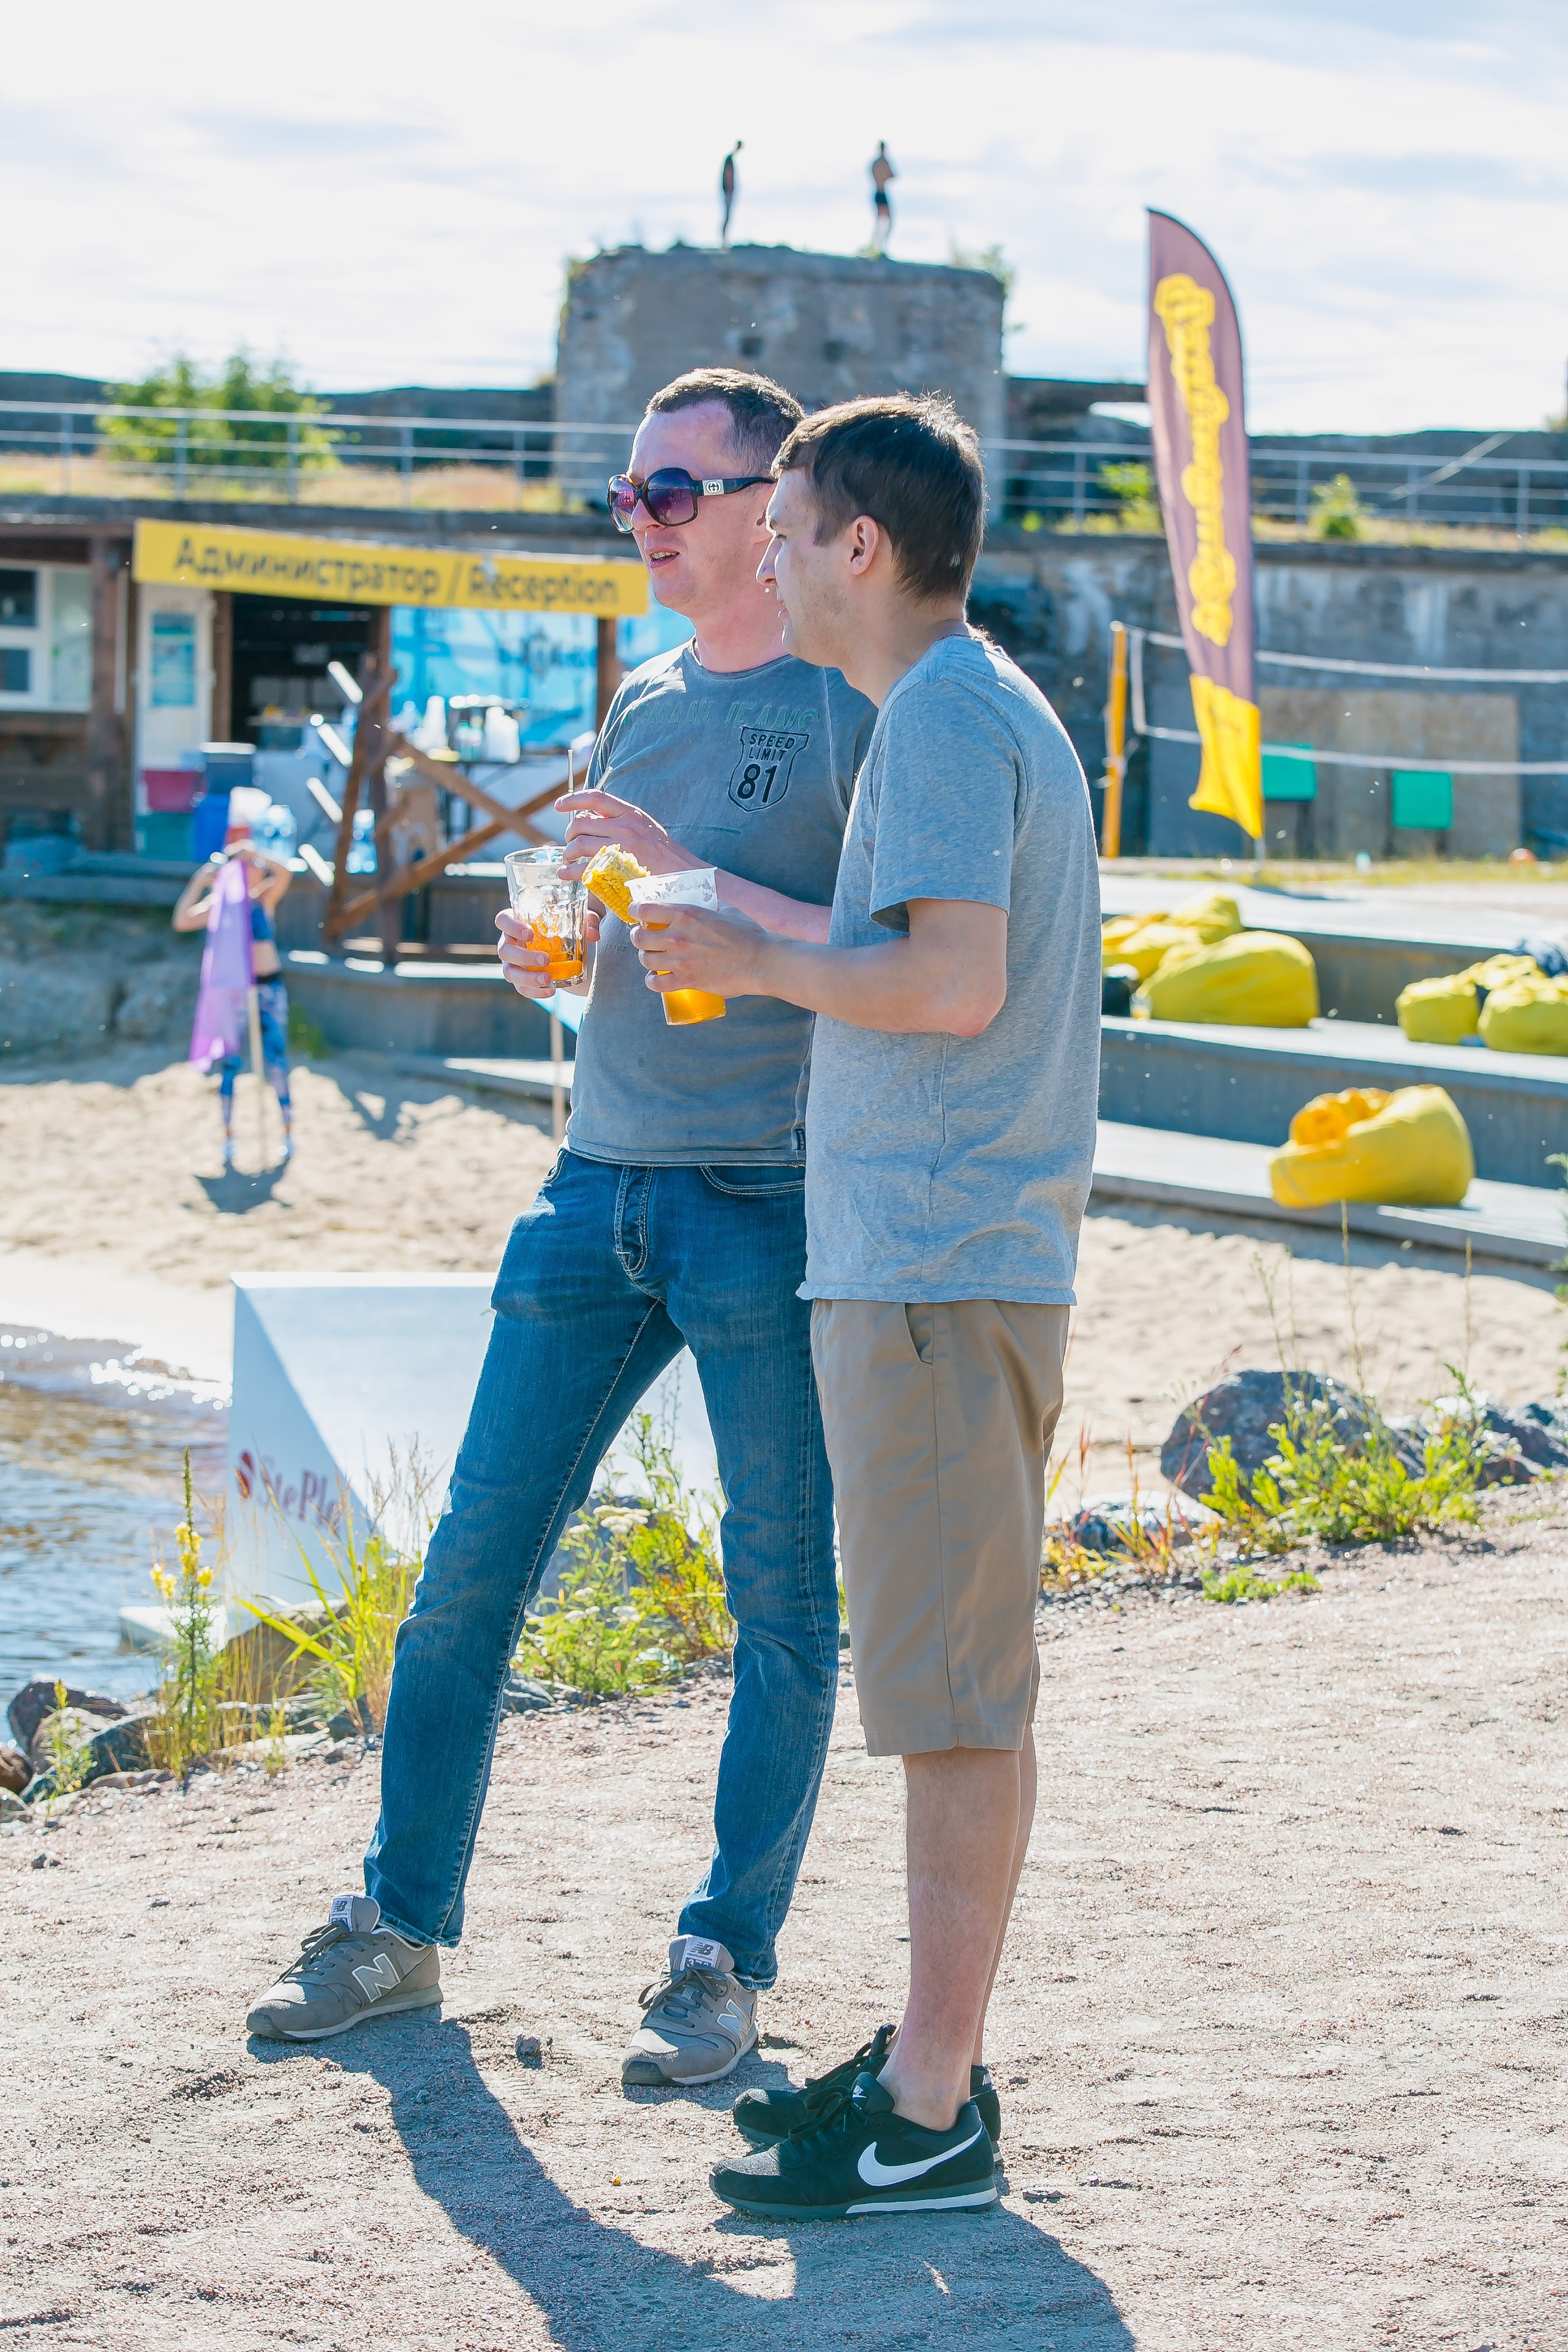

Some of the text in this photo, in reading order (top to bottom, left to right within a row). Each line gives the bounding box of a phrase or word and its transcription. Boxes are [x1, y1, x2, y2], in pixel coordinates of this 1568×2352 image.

[174, 538, 441, 602] Администратор
[469, 564, 620, 612] Reception
[748, 746, 787, 761] LIMIT
[749, 733, 796, 749] SPEED
[737, 763, 778, 803] 81
[351, 1953, 401, 2003] N
